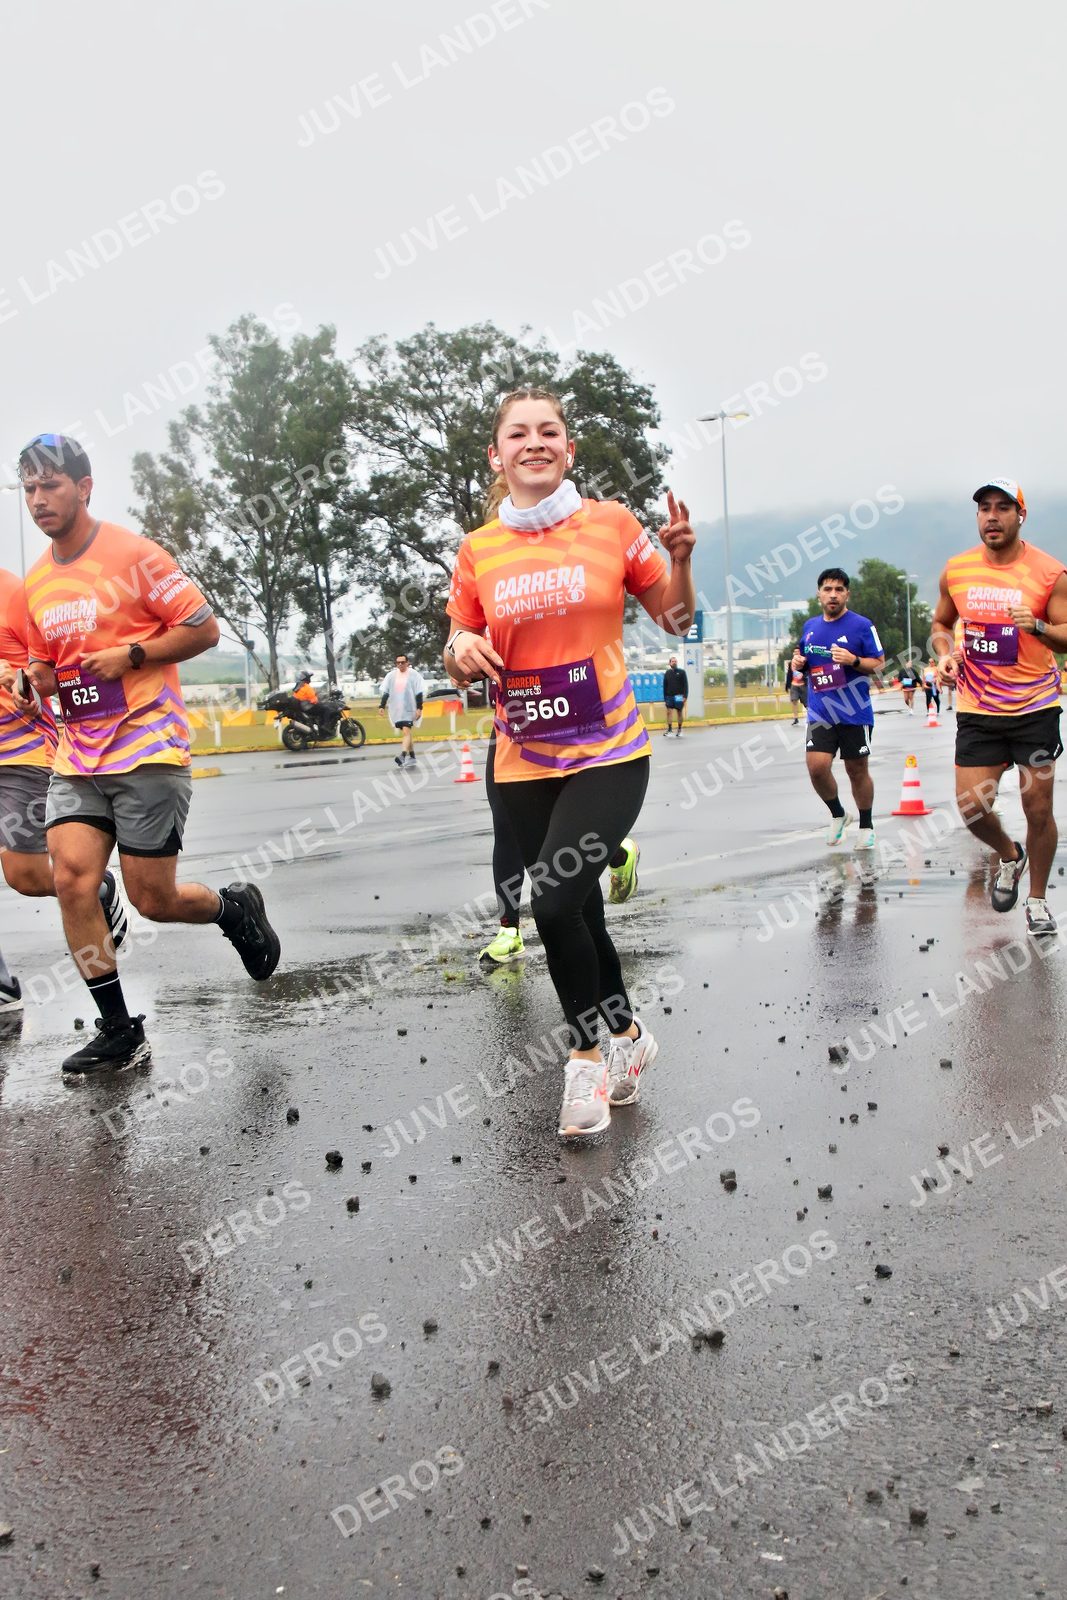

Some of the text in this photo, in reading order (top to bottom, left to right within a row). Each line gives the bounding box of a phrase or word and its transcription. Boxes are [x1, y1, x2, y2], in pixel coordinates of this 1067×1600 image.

[494, 564, 586, 602] CARRERA
[495, 590, 565, 618] OMNILIFE
[967, 587, 1023, 603] CARRERA
[43, 598, 97, 629] CARRERA
[972, 640, 998, 653] 438
[507, 675, 541, 689] CARRERA
[816, 675, 833, 686] 361
[71, 686, 100, 706] 625
[525, 697, 569, 721] 560
